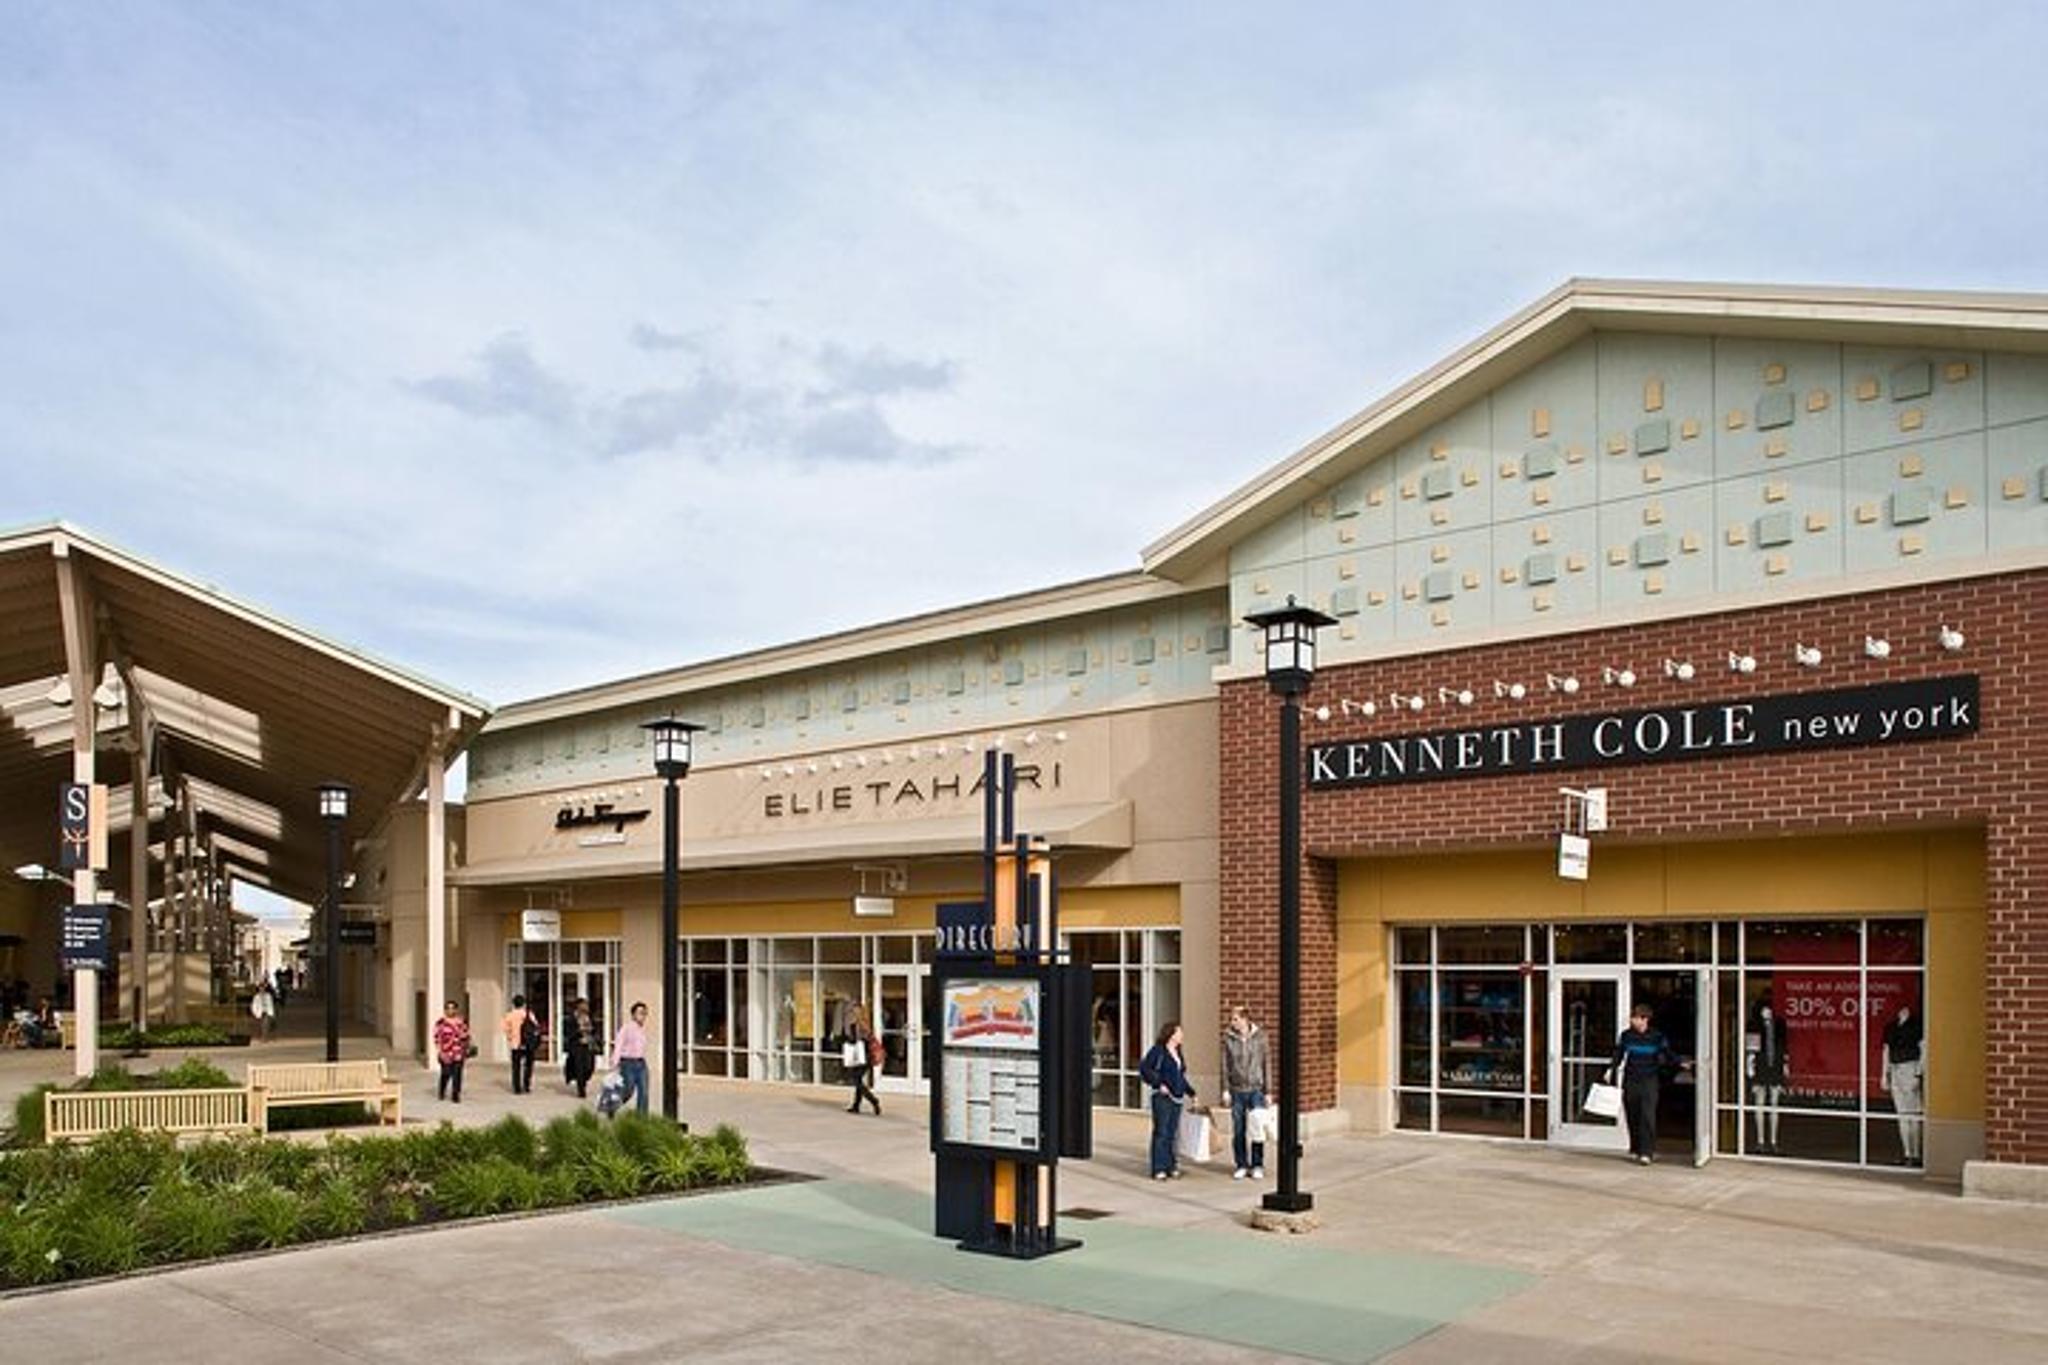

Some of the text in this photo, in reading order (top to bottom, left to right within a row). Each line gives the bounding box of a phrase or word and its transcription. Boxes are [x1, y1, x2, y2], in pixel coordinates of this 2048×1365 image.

[1311, 697, 1971, 782] KENNETH COLE new york
[66, 786, 87, 821] S
[765, 786, 852, 817] ELIE
[1785, 998, 1836, 1016] 30%
